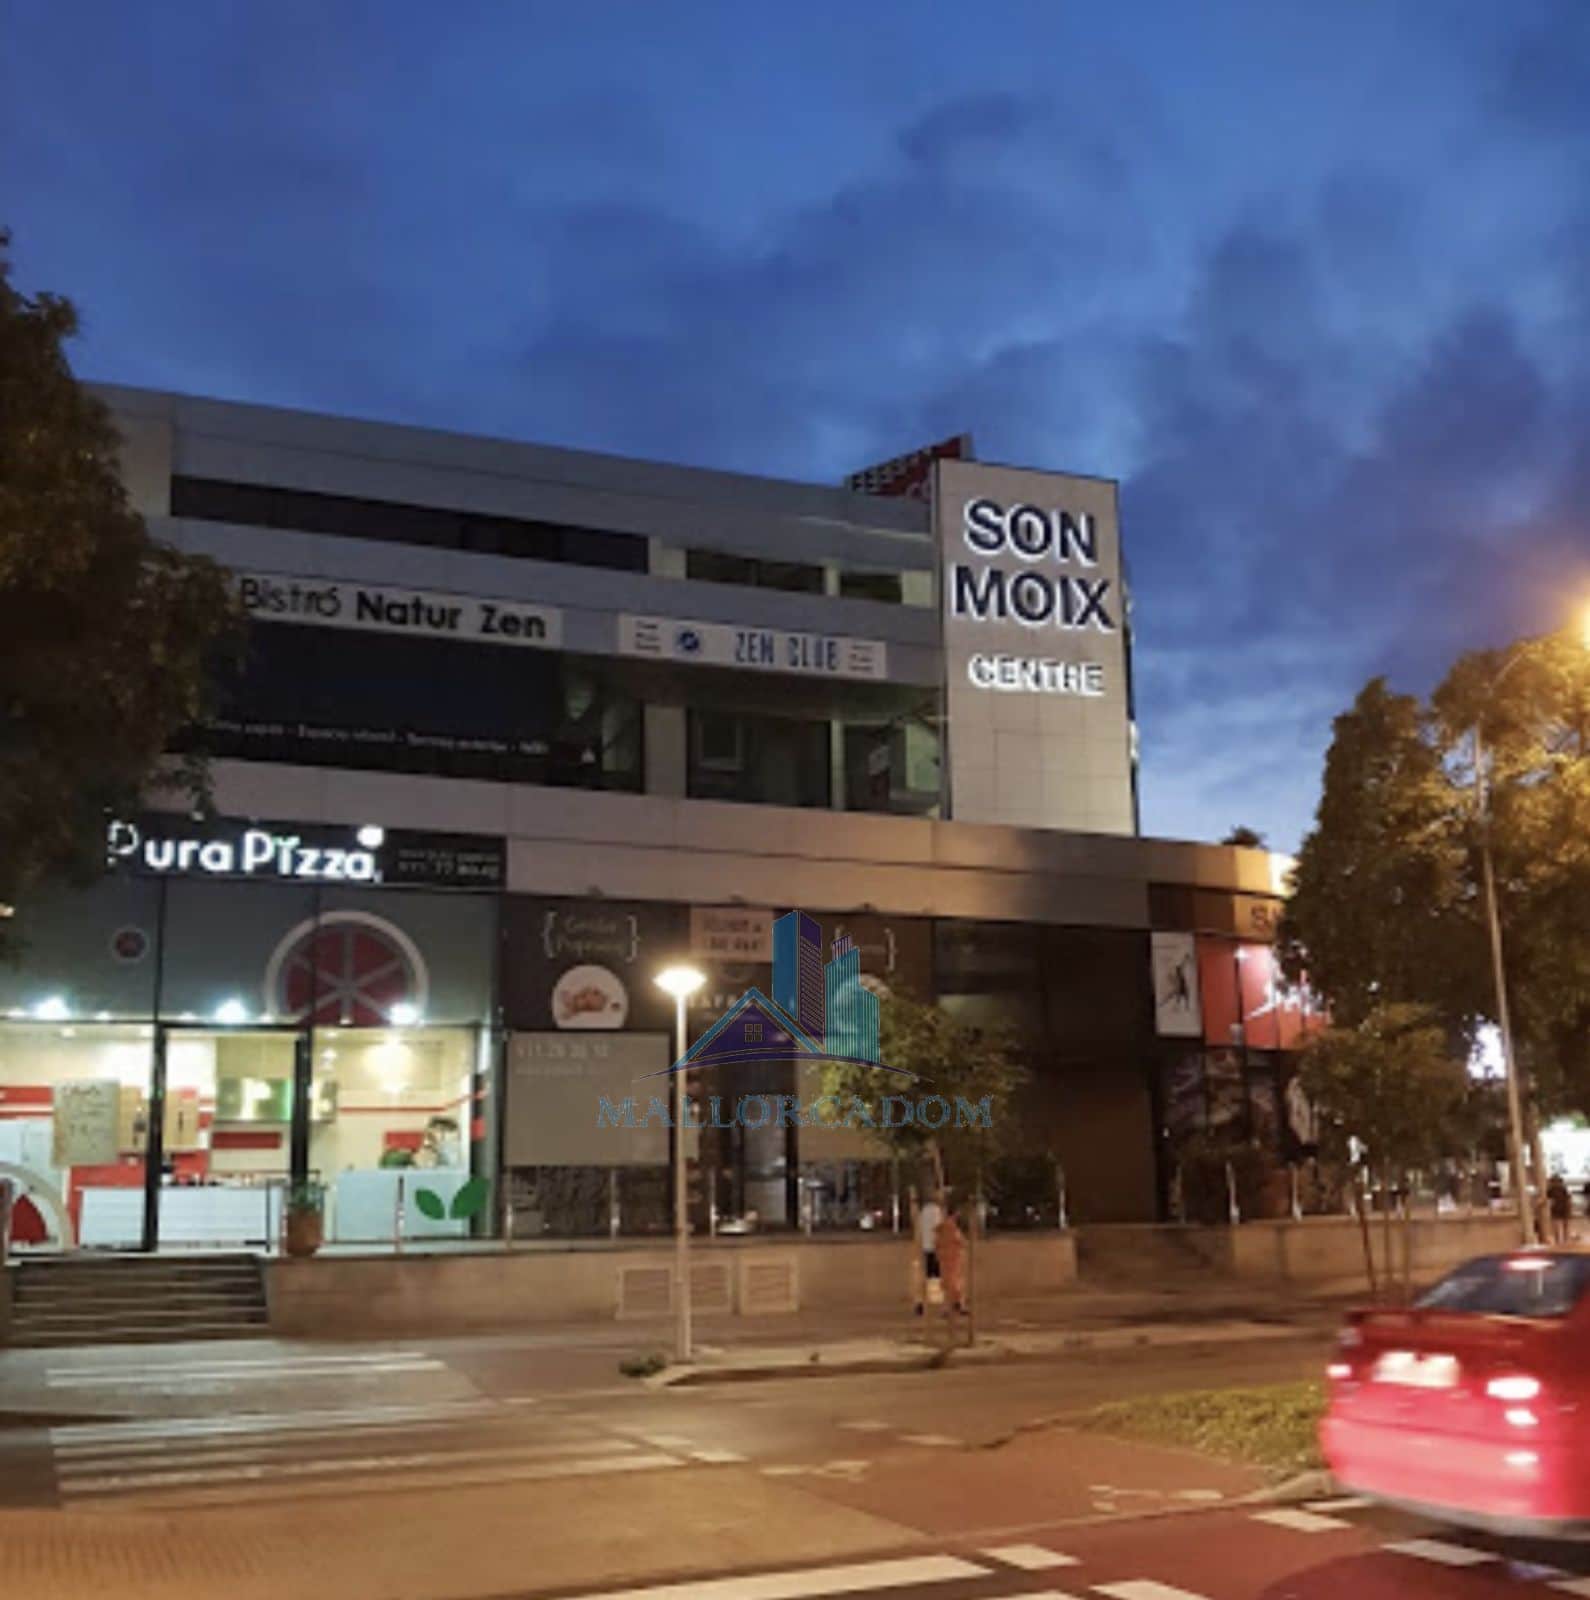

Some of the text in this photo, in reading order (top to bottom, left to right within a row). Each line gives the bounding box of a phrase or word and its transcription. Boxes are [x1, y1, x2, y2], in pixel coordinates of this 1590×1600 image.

[964, 497, 1097, 567] SON
[241, 577, 547, 639] Bistró Natur Zen
[950, 563, 1116, 634] MOIX
[735, 631, 774, 665] ZEN
[967, 654, 1105, 697] CENTRE
[107, 820, 378, 880] Pura Pizza
